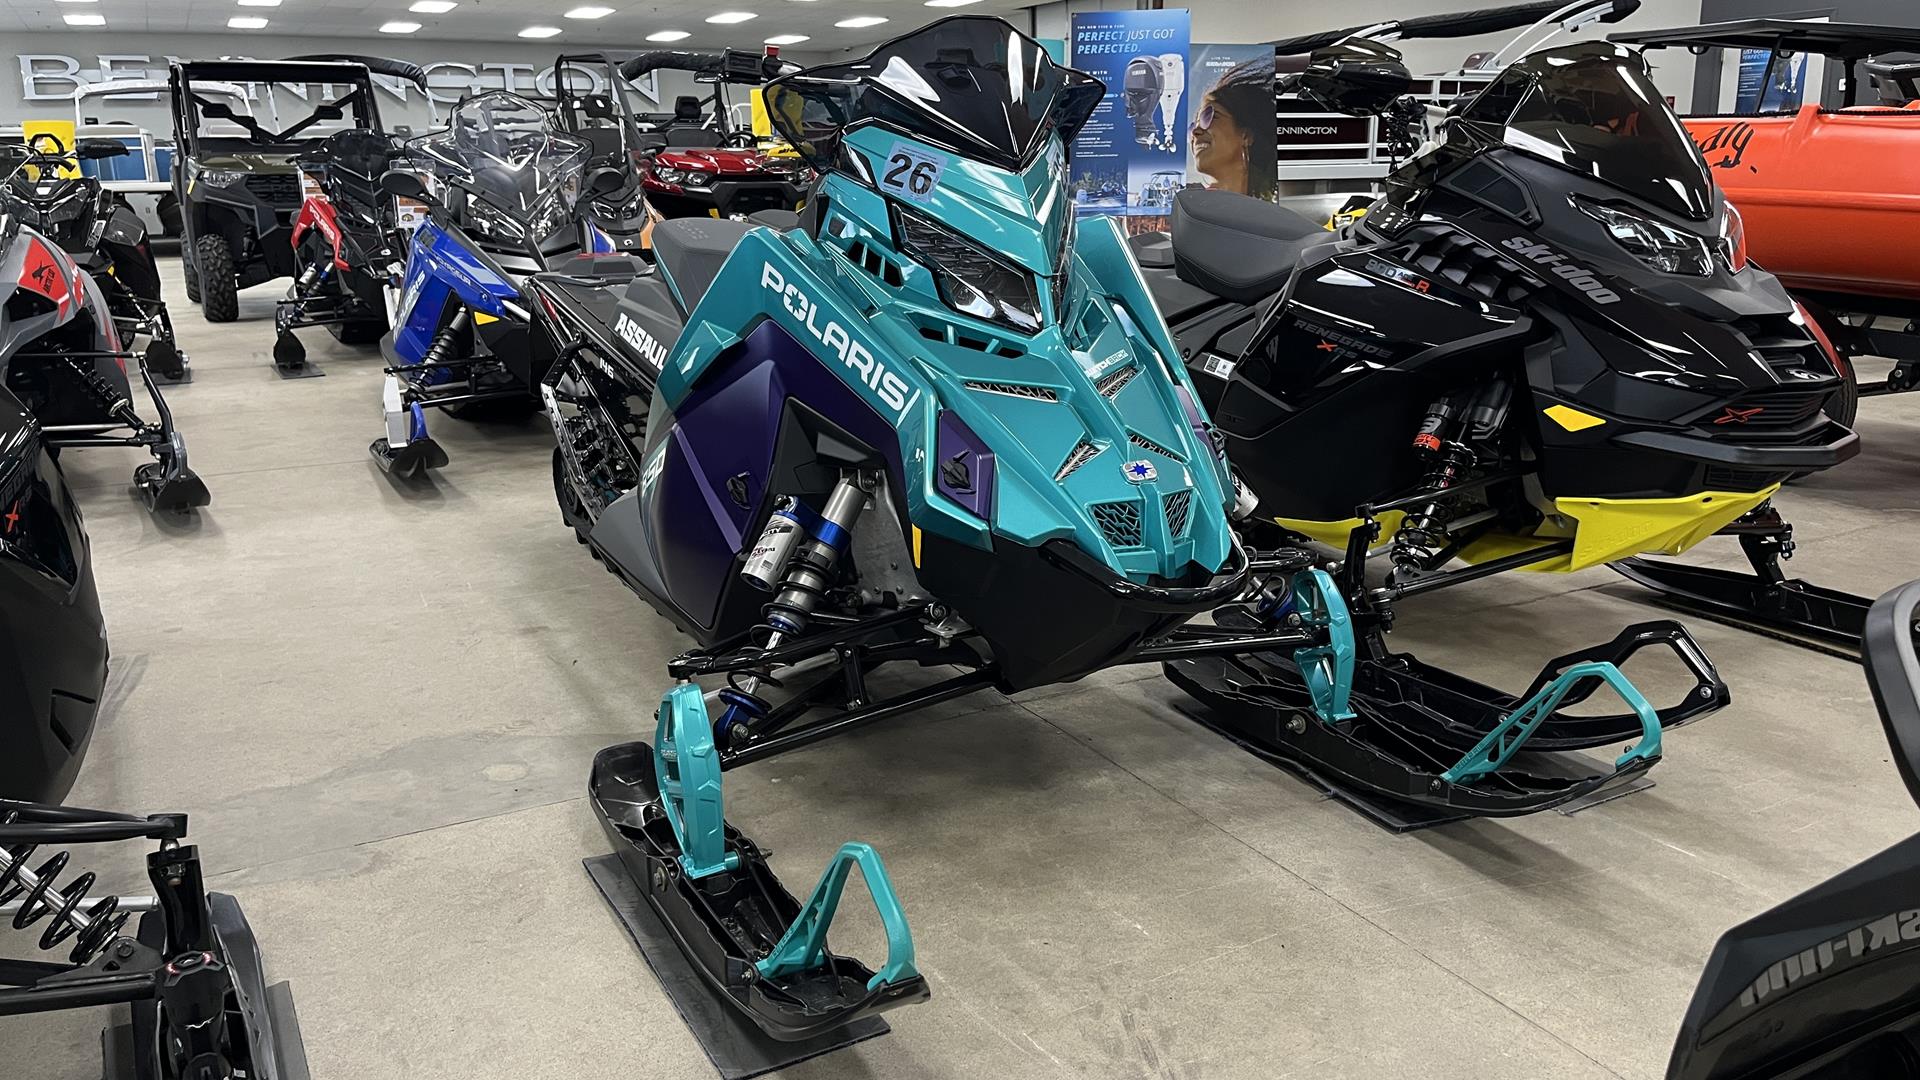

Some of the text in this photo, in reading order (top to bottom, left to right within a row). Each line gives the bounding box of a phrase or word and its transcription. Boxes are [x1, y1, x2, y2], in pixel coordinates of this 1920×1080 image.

[1077, 28, 1175, 42] PERFECT JUST GOT
[1077, 43, 1142, 54] PERFECTED.
[1277, 126, 1338, 135] ENNINGTON
[883, 153, 937, 195] 26
[1501, 236, 1621, 305] ski-doo
[614, 312, 668, 371] ASSAUL
[760, 261, 910, 411] POLARIS
[1293, 319, 1394, 358] RENEGADE
[599, 357, 614, 379] 146
[641, 447, 667, 498] 850
